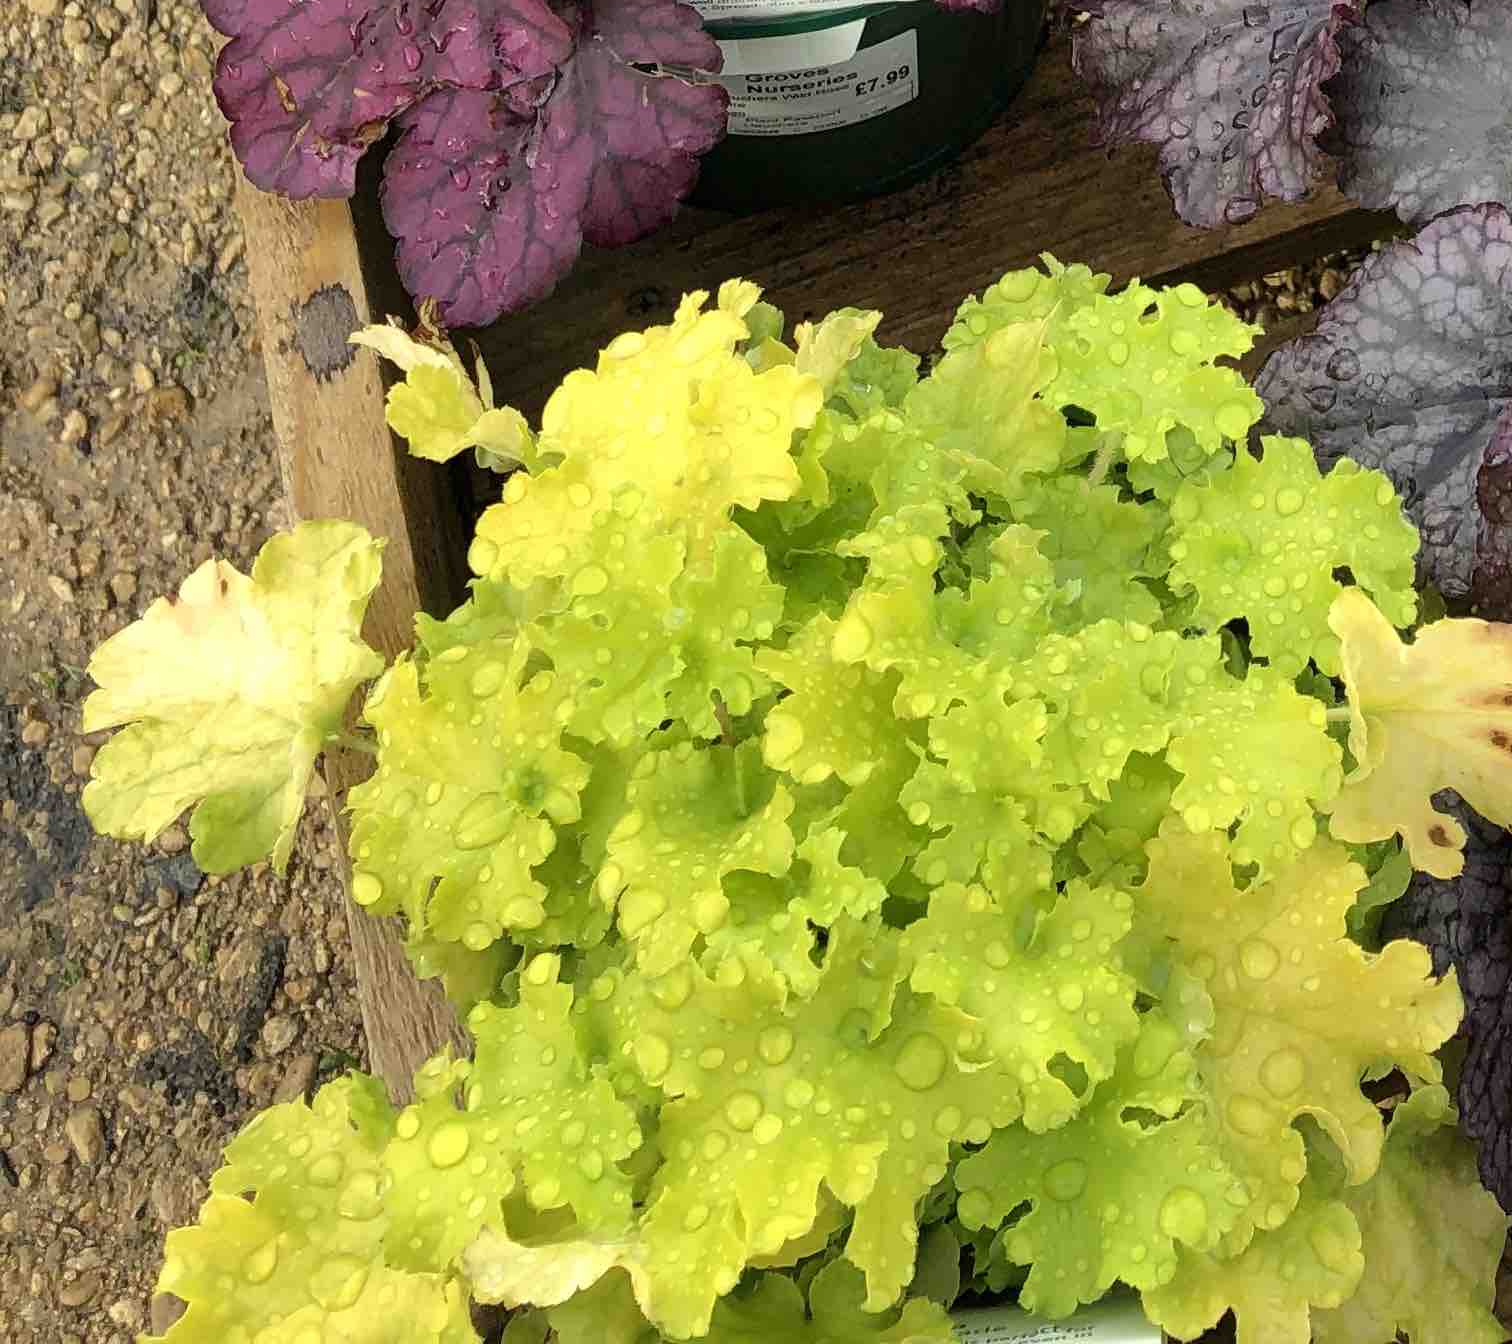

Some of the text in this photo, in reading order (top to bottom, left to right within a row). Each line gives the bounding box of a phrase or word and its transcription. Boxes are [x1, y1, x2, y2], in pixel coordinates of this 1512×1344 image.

[745, 67, 829, 83] Groves
[747, 71, 858, 94] Nurseries
[855, 64, 911, 97] £7.99
